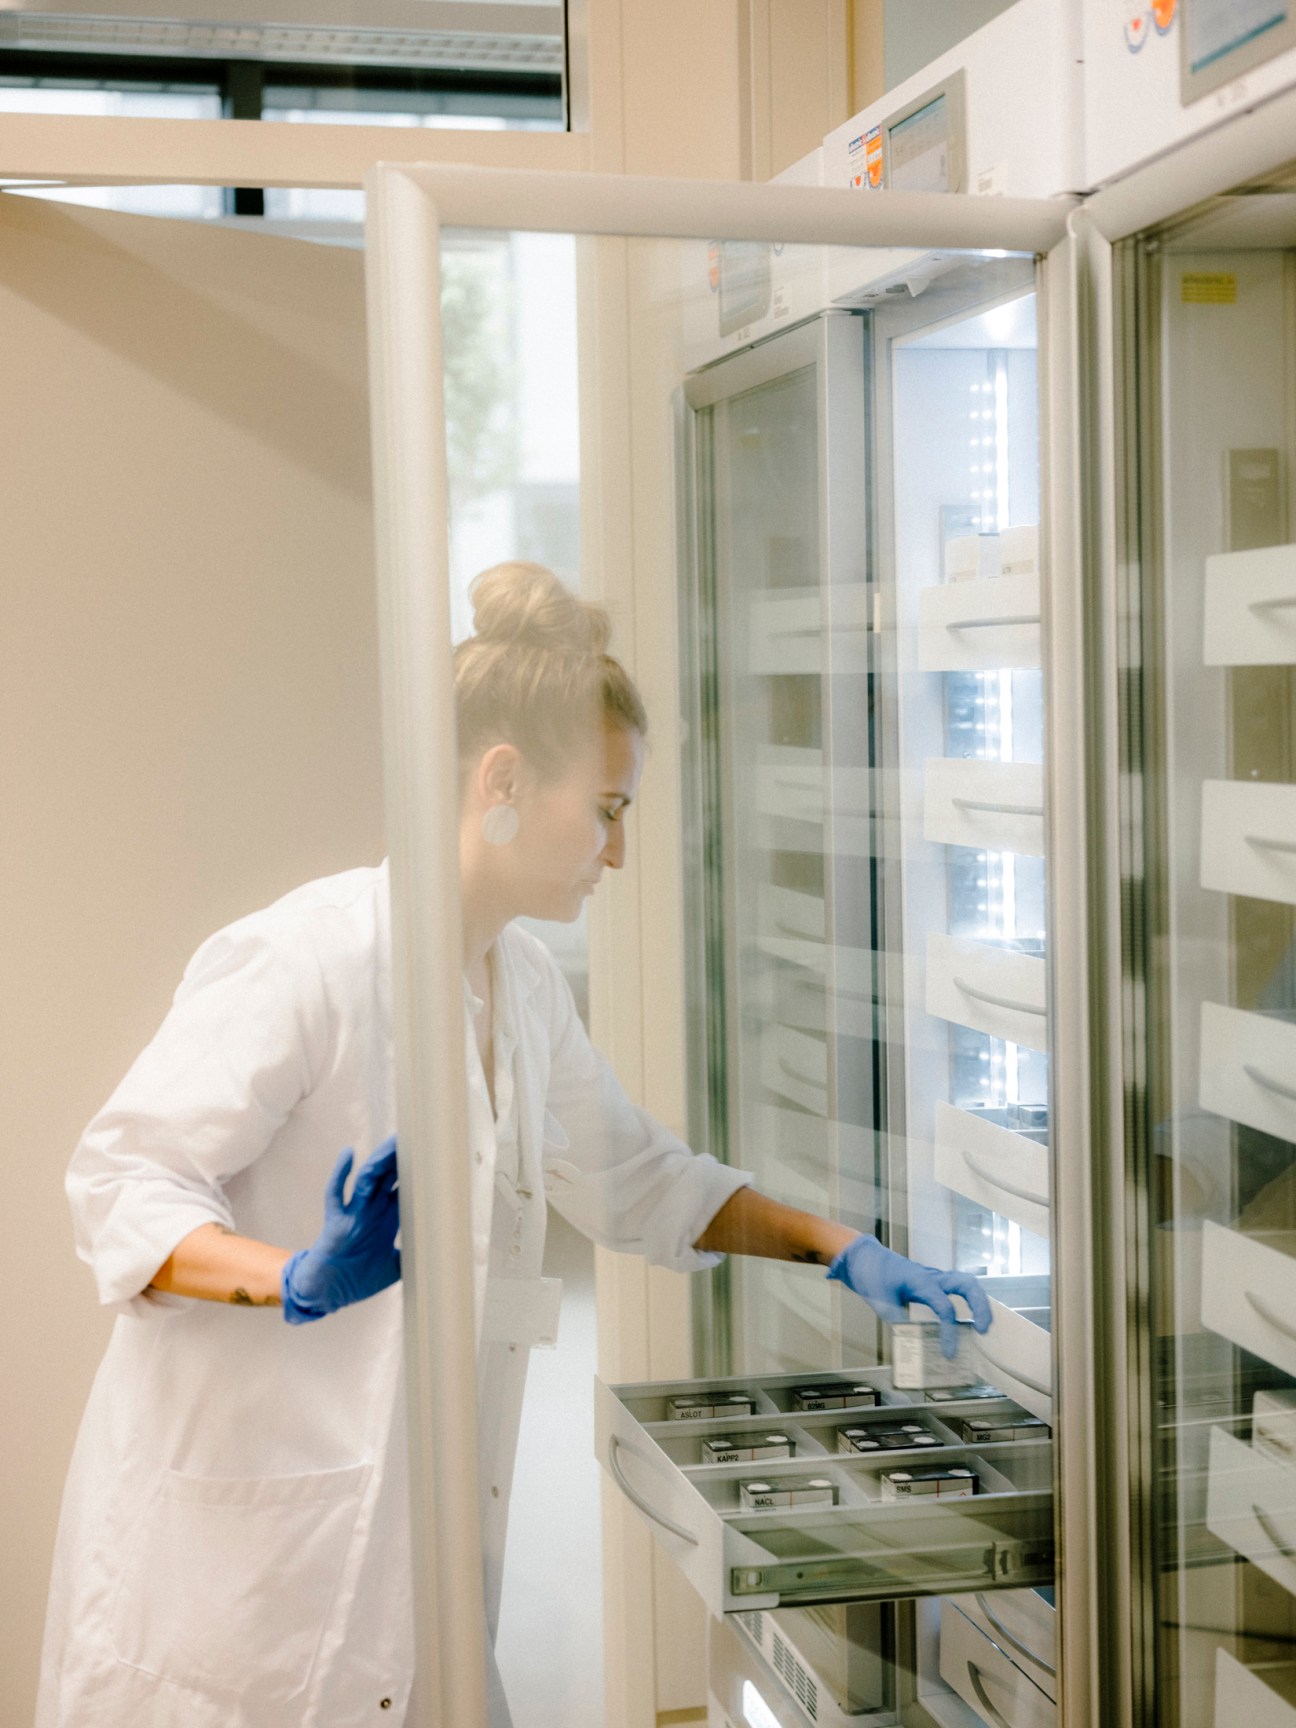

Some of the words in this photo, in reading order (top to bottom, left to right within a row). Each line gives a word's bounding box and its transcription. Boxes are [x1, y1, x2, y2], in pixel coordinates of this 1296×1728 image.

[680, 1411, 702, 1419] ASLOT
[976, 1433, 991, 1441] MG2
[717, 1454, 739, 1463] KAPP2
[896, 1485, 912, 1493] SMS
[754, 1498, 774, 1506] NACL
